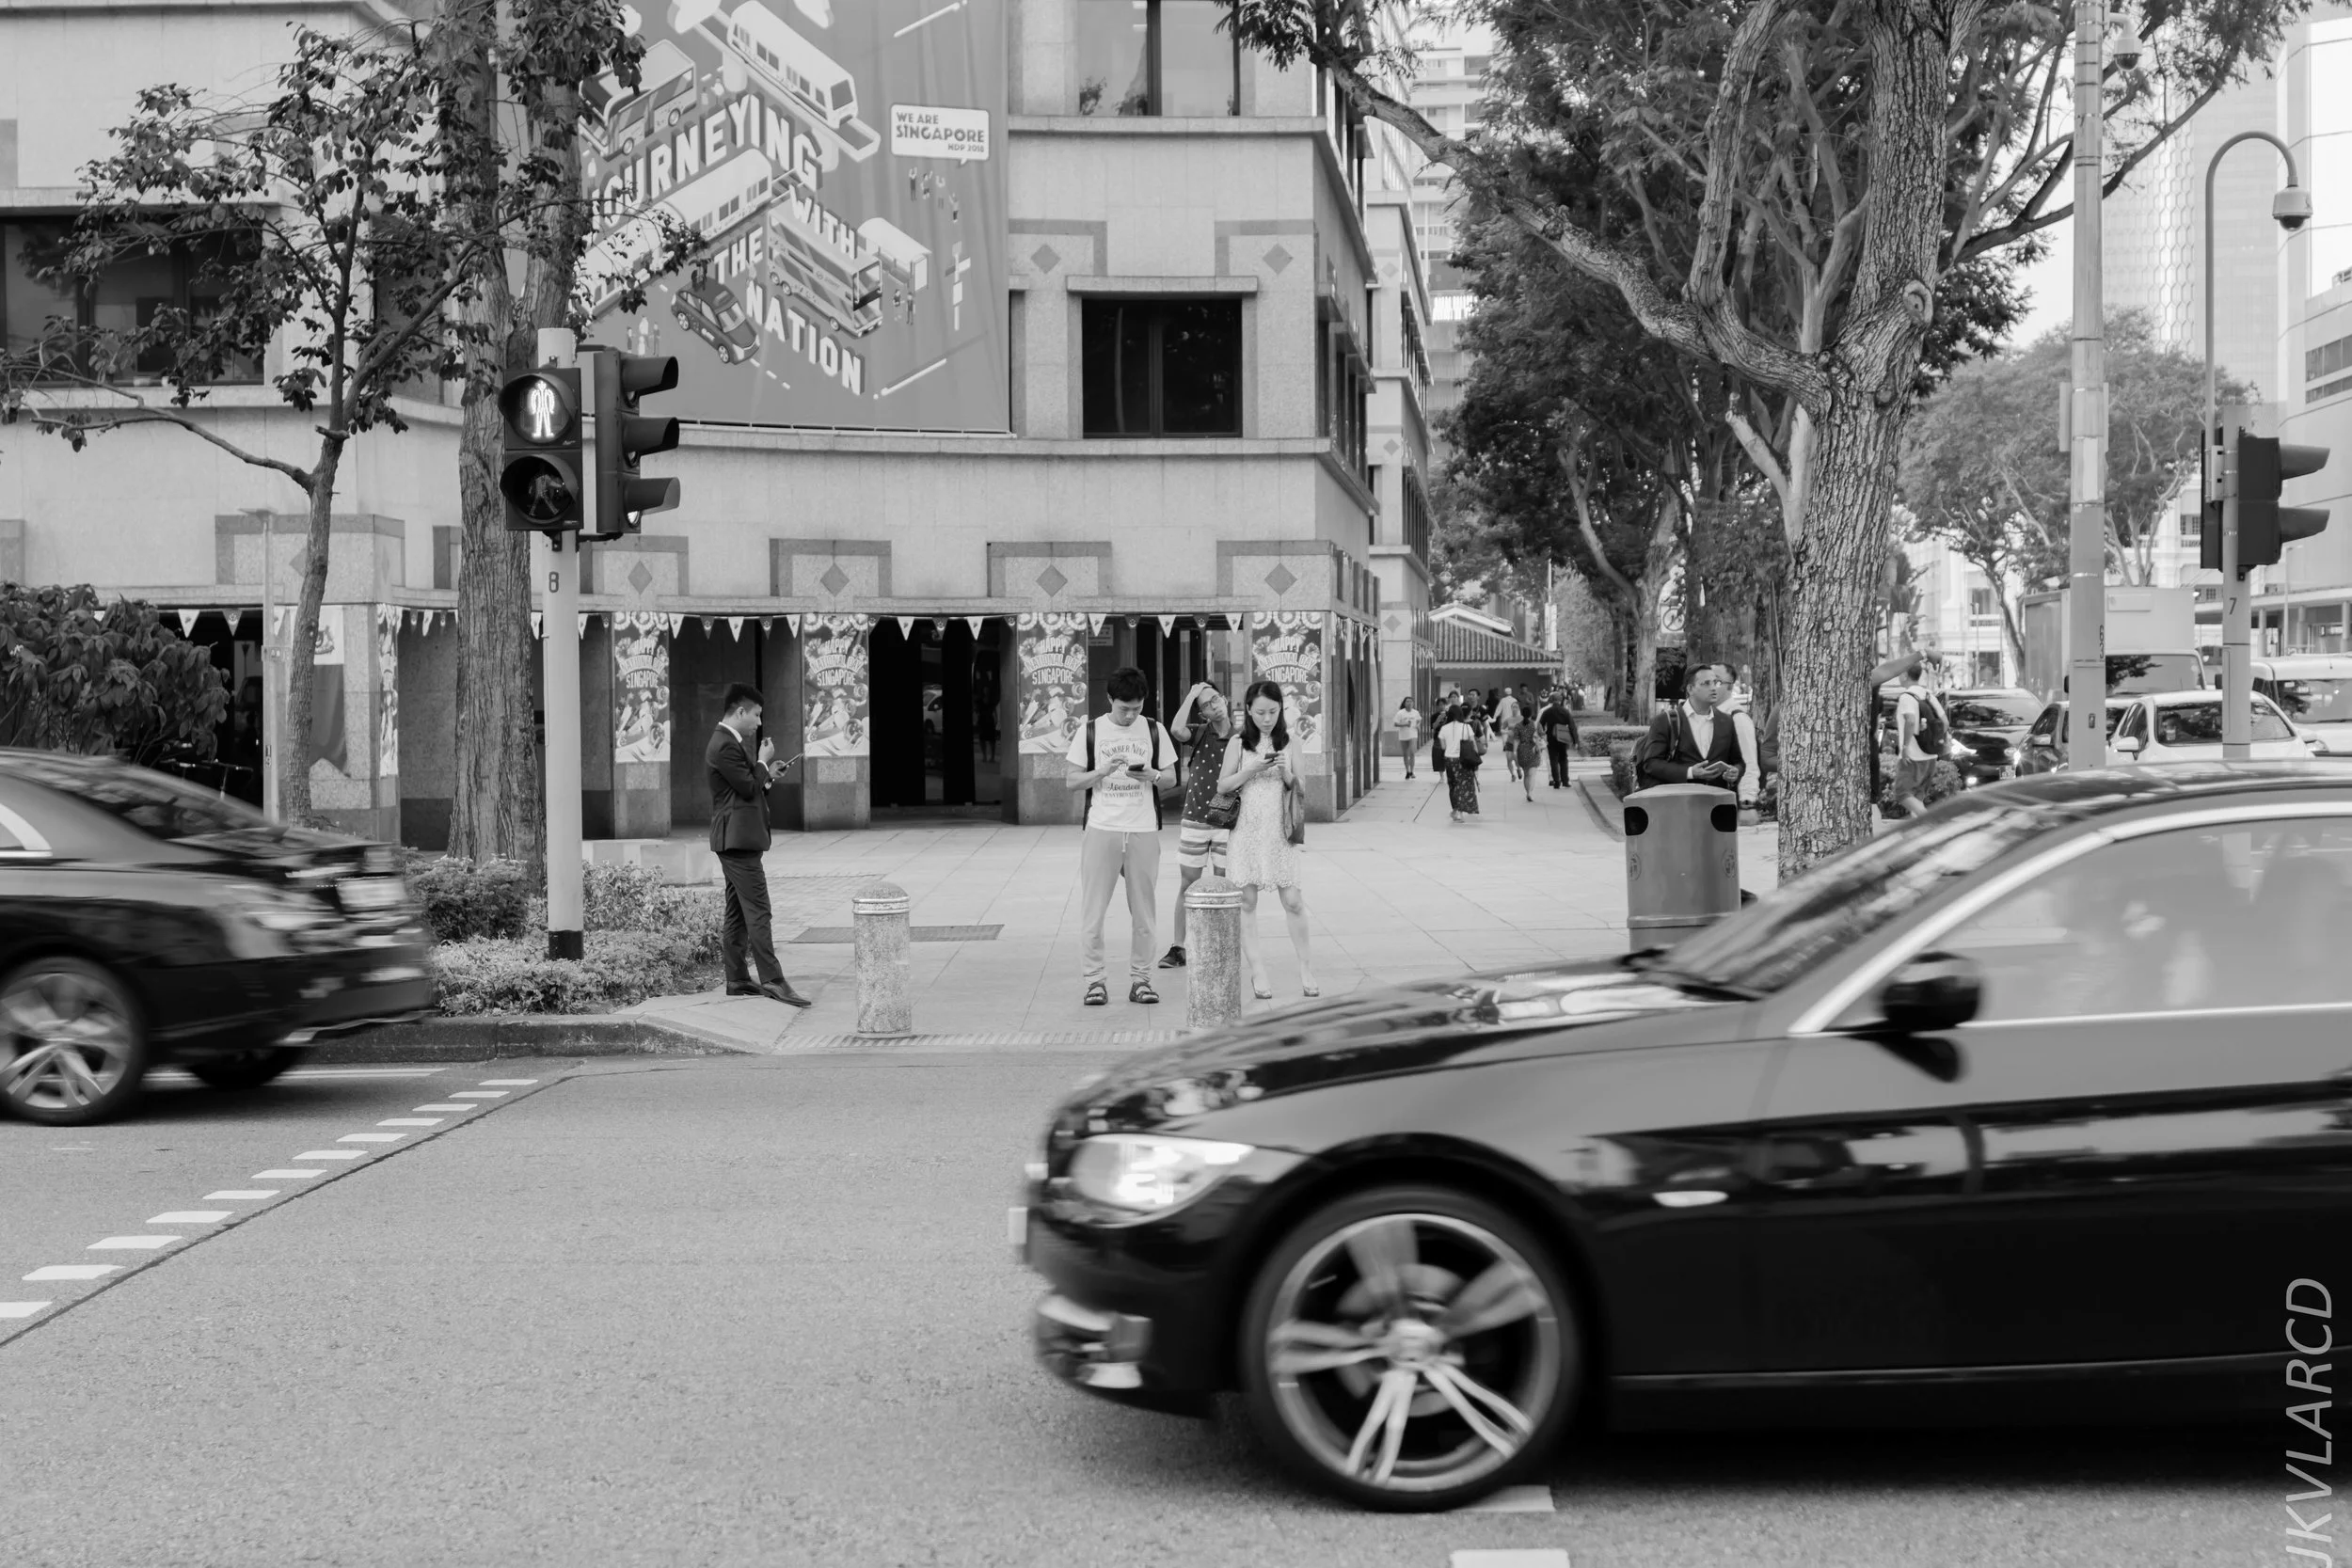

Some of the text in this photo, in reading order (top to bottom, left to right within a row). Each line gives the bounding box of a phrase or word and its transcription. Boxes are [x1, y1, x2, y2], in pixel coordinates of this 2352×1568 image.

[896, 112, 939, 125] WE ARE
[896, 125, 985, 143] SINGAPORE
[788, 184, 857, 260] WITH
[714, 226, 763, 284] THE
[746, 280, 861, 395] NATION
[548, 571, 560, 594] 8
[2229, 597, 2237, 615] 7
[1041, 637, 1066, 654] HAPPY
[1275, 636, 1300, 653] HAPPY
[817, 669, 856, 687] SINGAPORE
[1032, 666, 1074, 685] SINGAPORE
[1265, 666, 1308, 683] SINGAPORE
